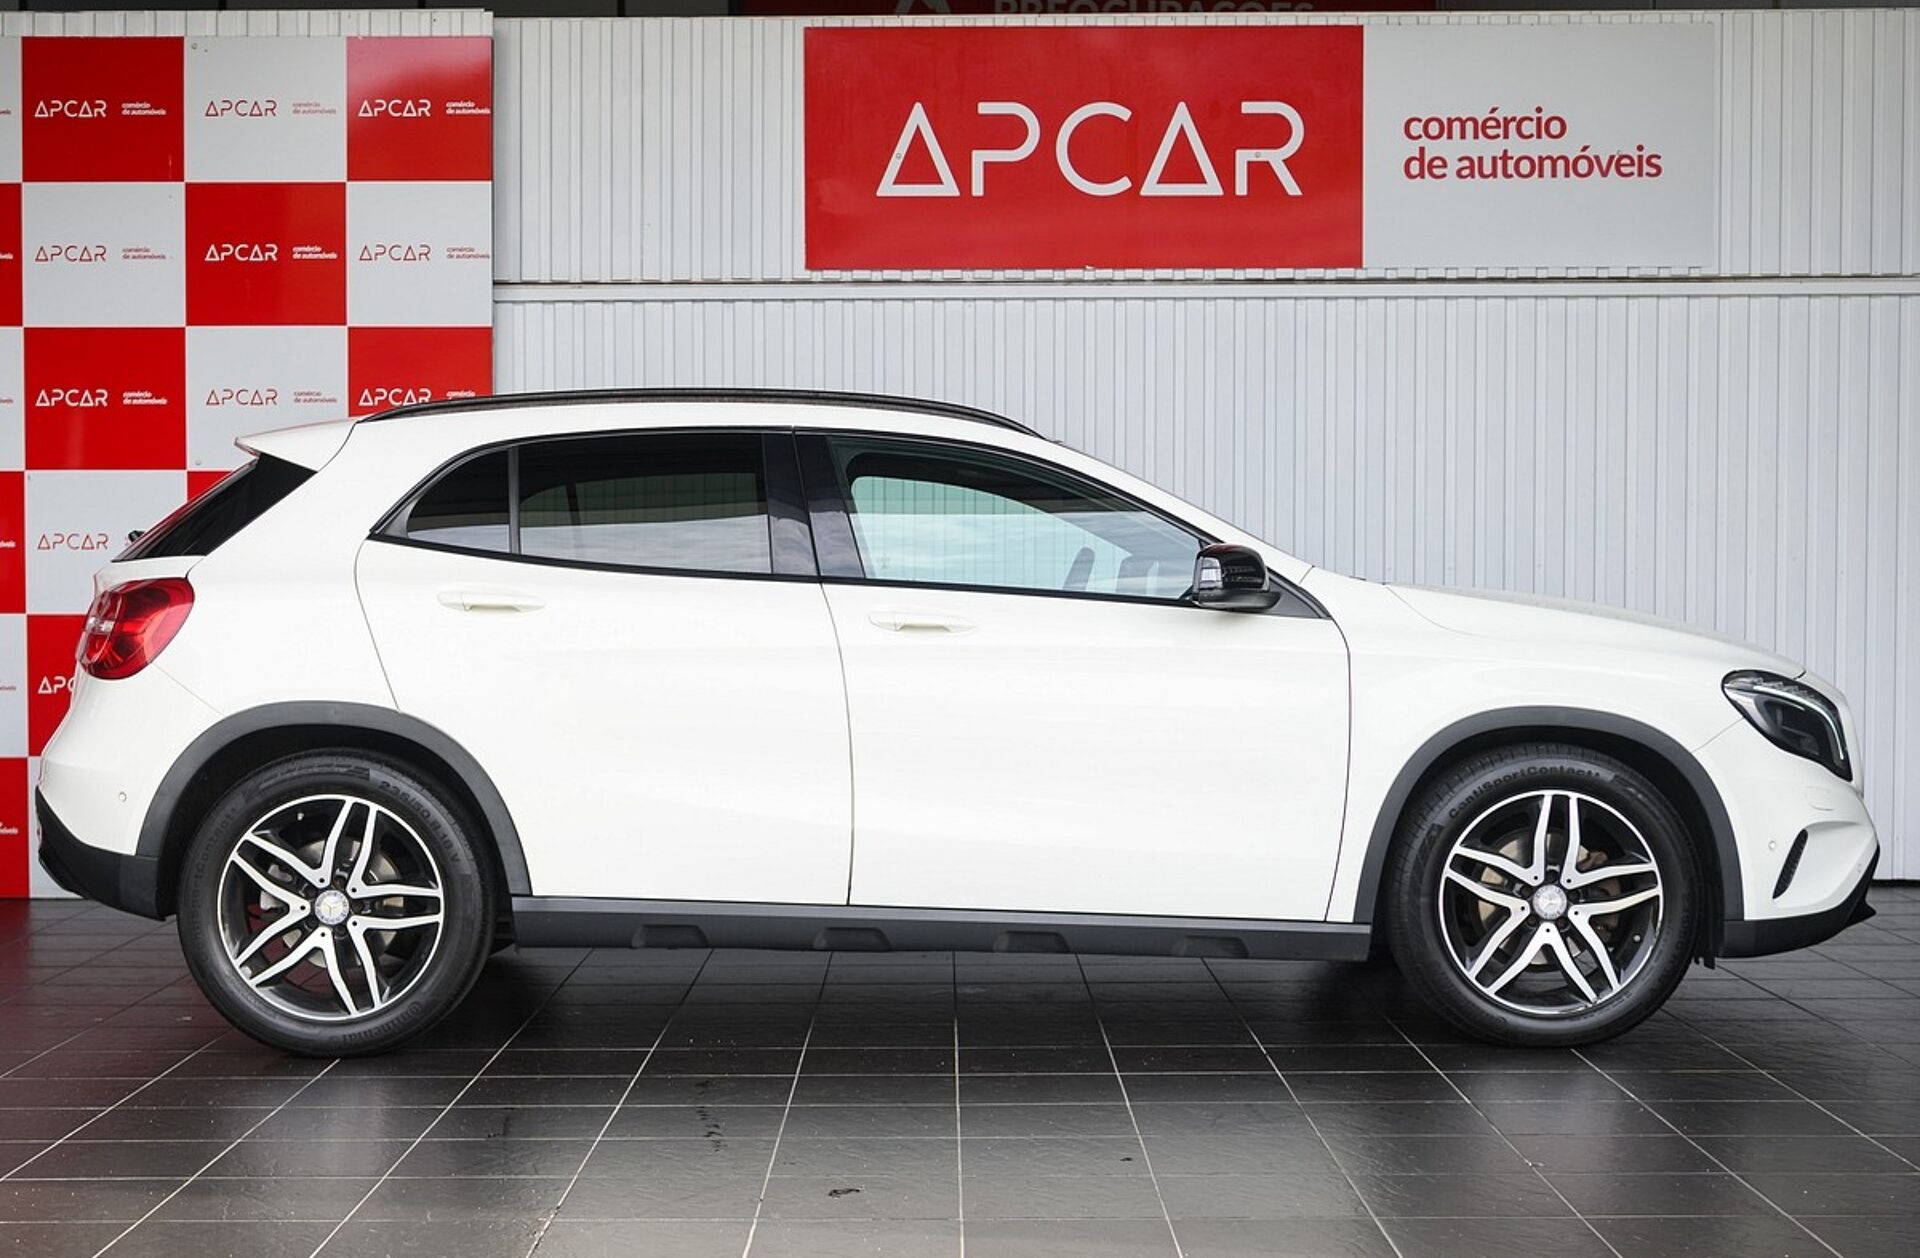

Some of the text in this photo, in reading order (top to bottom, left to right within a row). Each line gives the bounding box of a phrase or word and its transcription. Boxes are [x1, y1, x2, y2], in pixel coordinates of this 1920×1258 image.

[35, 100, 107, 117] APCAR
[205, 99, 278, 117] APCAR
[358, 99, 431, 117] APCAR
[1403, 105, 1568, 141] comércio
[876, 101, 1305, 197] APCAR
[1403, 144, 1663, 180] de automóveis
[35, 245, 107, 262] APCAR
[205, 244, 278, 261] APCAR
[359, 244, 431, 261] APCAR
[35, 388, 108, 407] APCAR
[206, 388, 278, 405] APCAR
[358, 388, 432, 407] APCAR
[37, 533, 109, 550] APCAR
